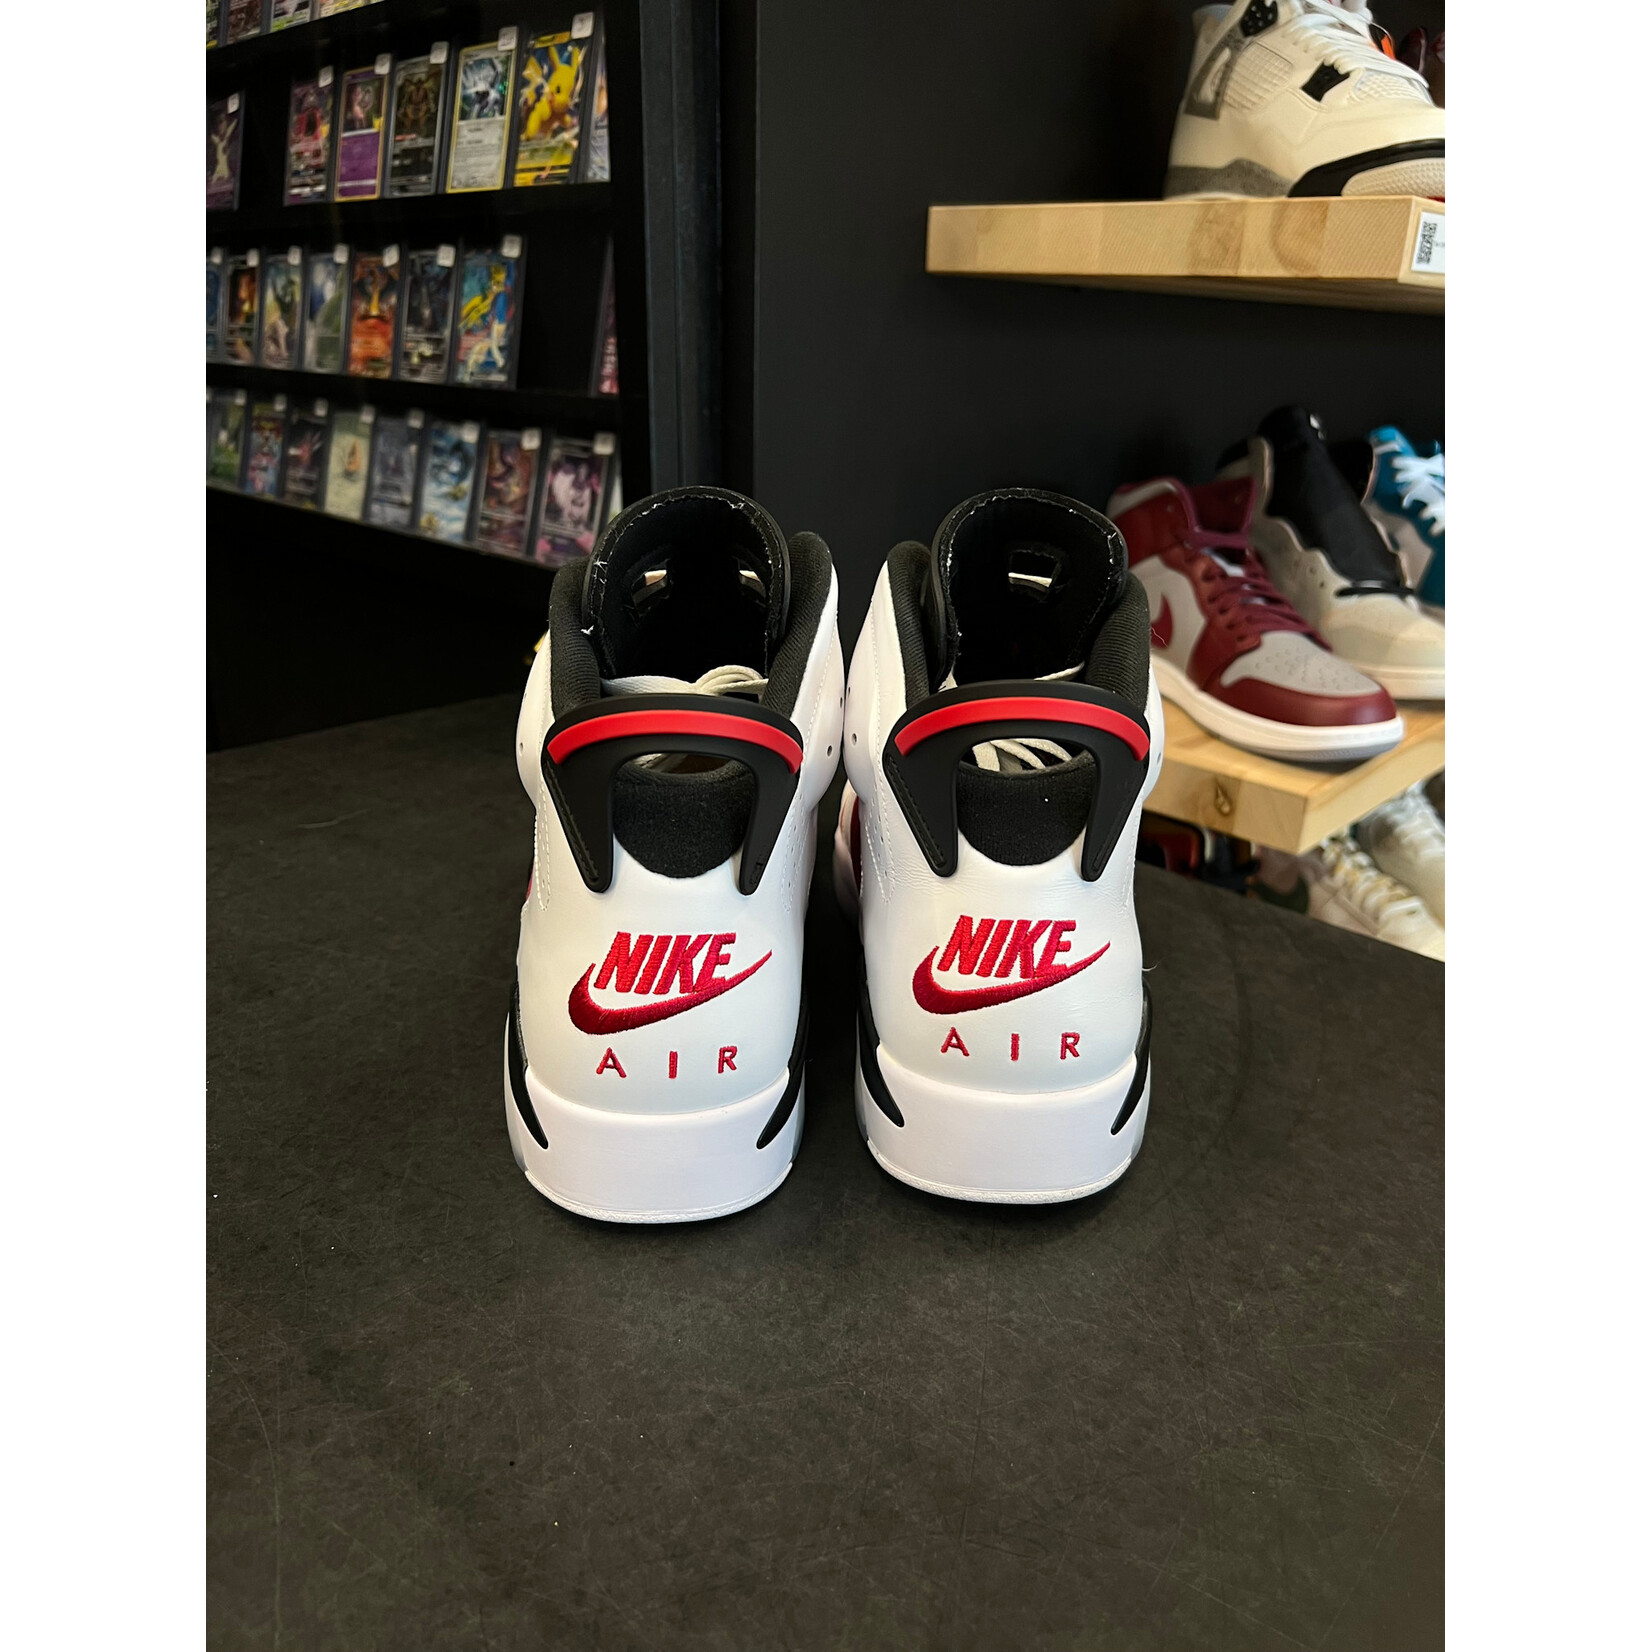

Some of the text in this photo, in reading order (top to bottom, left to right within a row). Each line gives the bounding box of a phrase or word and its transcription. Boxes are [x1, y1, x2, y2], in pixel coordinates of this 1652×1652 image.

[594, 931, 736, 995] NIKE
[938, 915, 1076, 978] NIKE
[596, 1045, 738, 1079] AIR
[941, 1026, 1081, 1061] AIR
